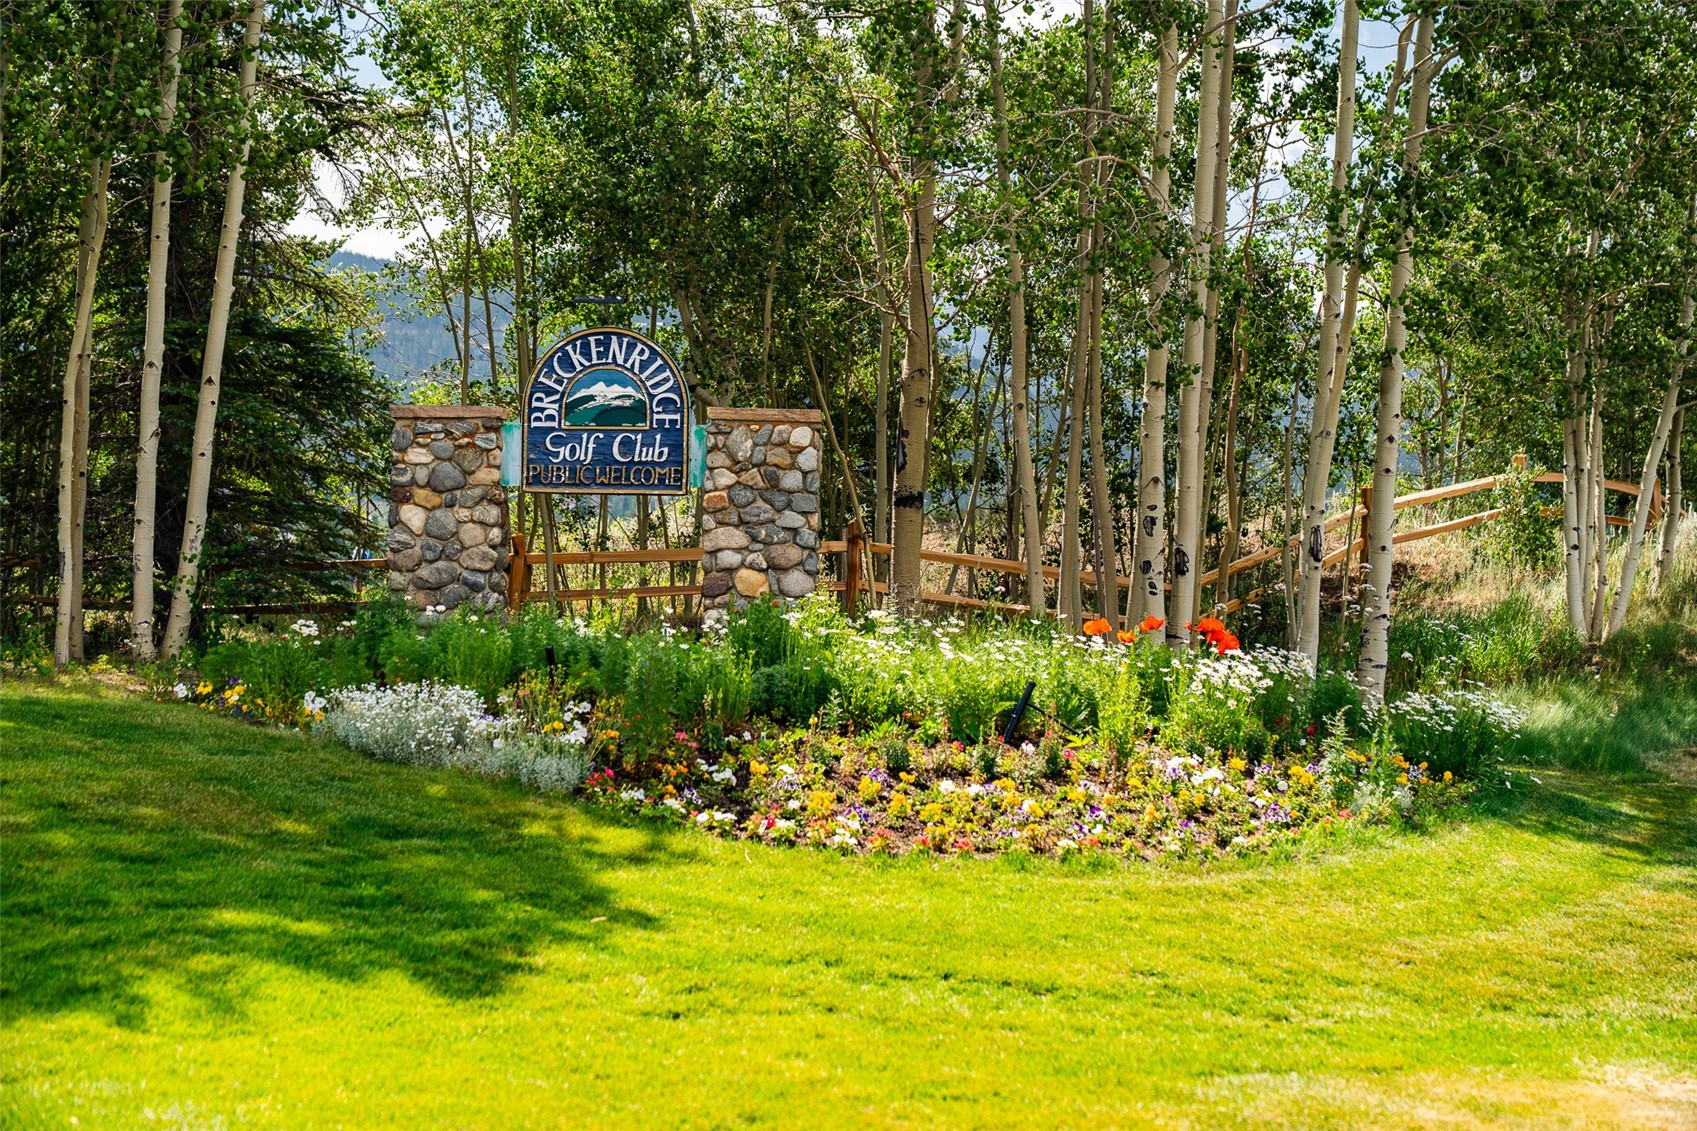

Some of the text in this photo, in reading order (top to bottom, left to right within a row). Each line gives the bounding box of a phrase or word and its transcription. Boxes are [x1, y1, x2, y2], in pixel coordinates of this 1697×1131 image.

[530, 335, 681, 429] BRECKENRIDGE
[545, 431, 669, 465] Golf Club
[528, 465, 682, 486] PUBLIC WELCOME
